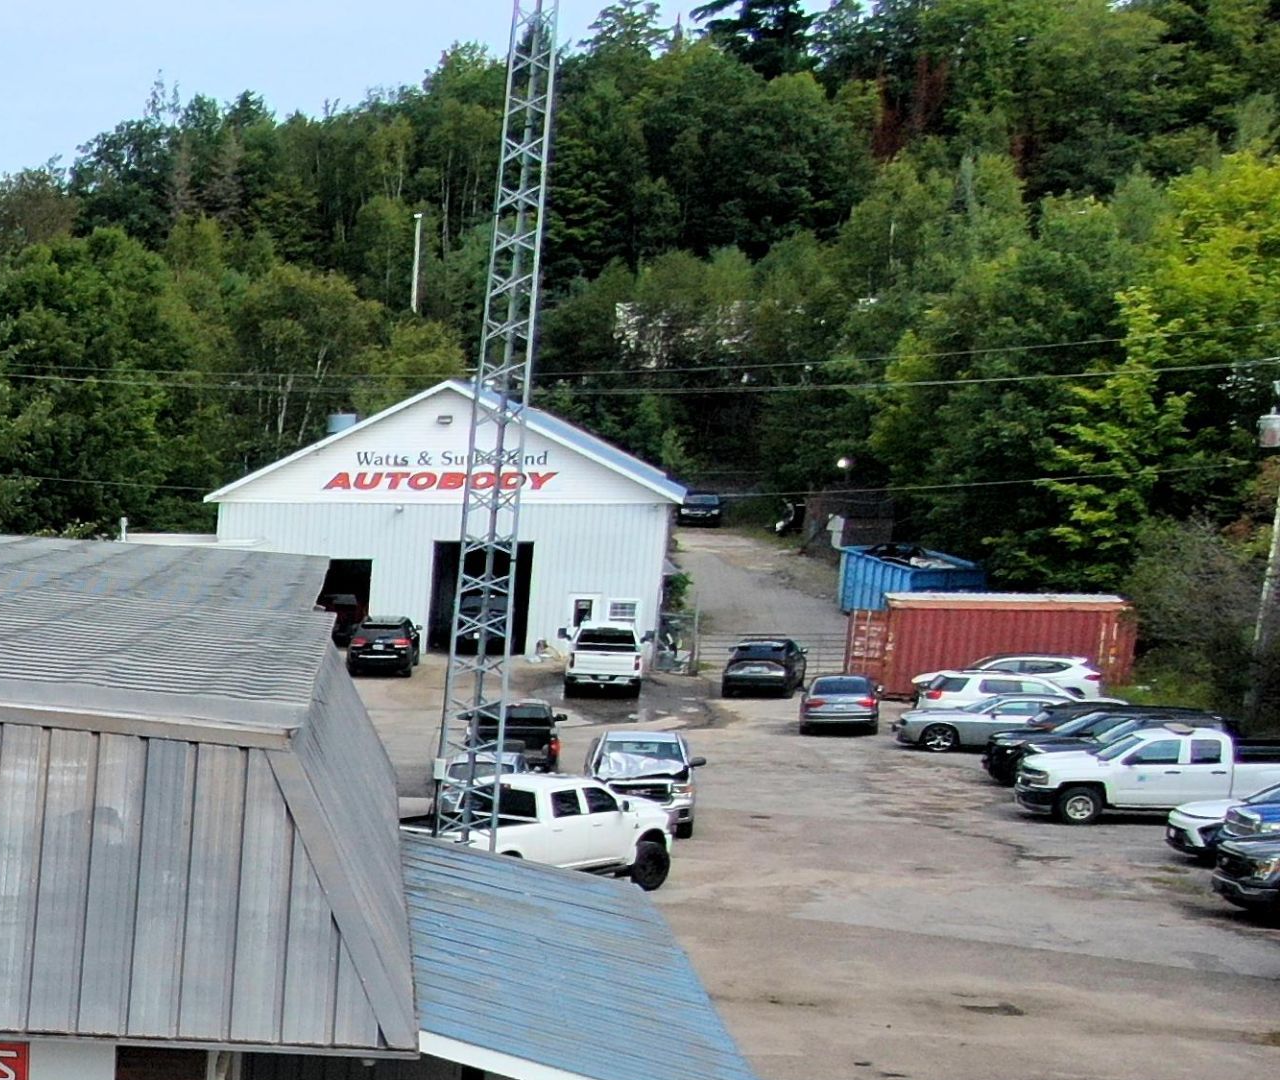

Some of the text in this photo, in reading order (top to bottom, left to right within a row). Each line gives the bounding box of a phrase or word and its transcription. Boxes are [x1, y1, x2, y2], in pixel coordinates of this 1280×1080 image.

[356, 450, 410, 467] Watts
[417, 451, 433, 466] &
[322, 471, 560, 490] AUTOBODY
